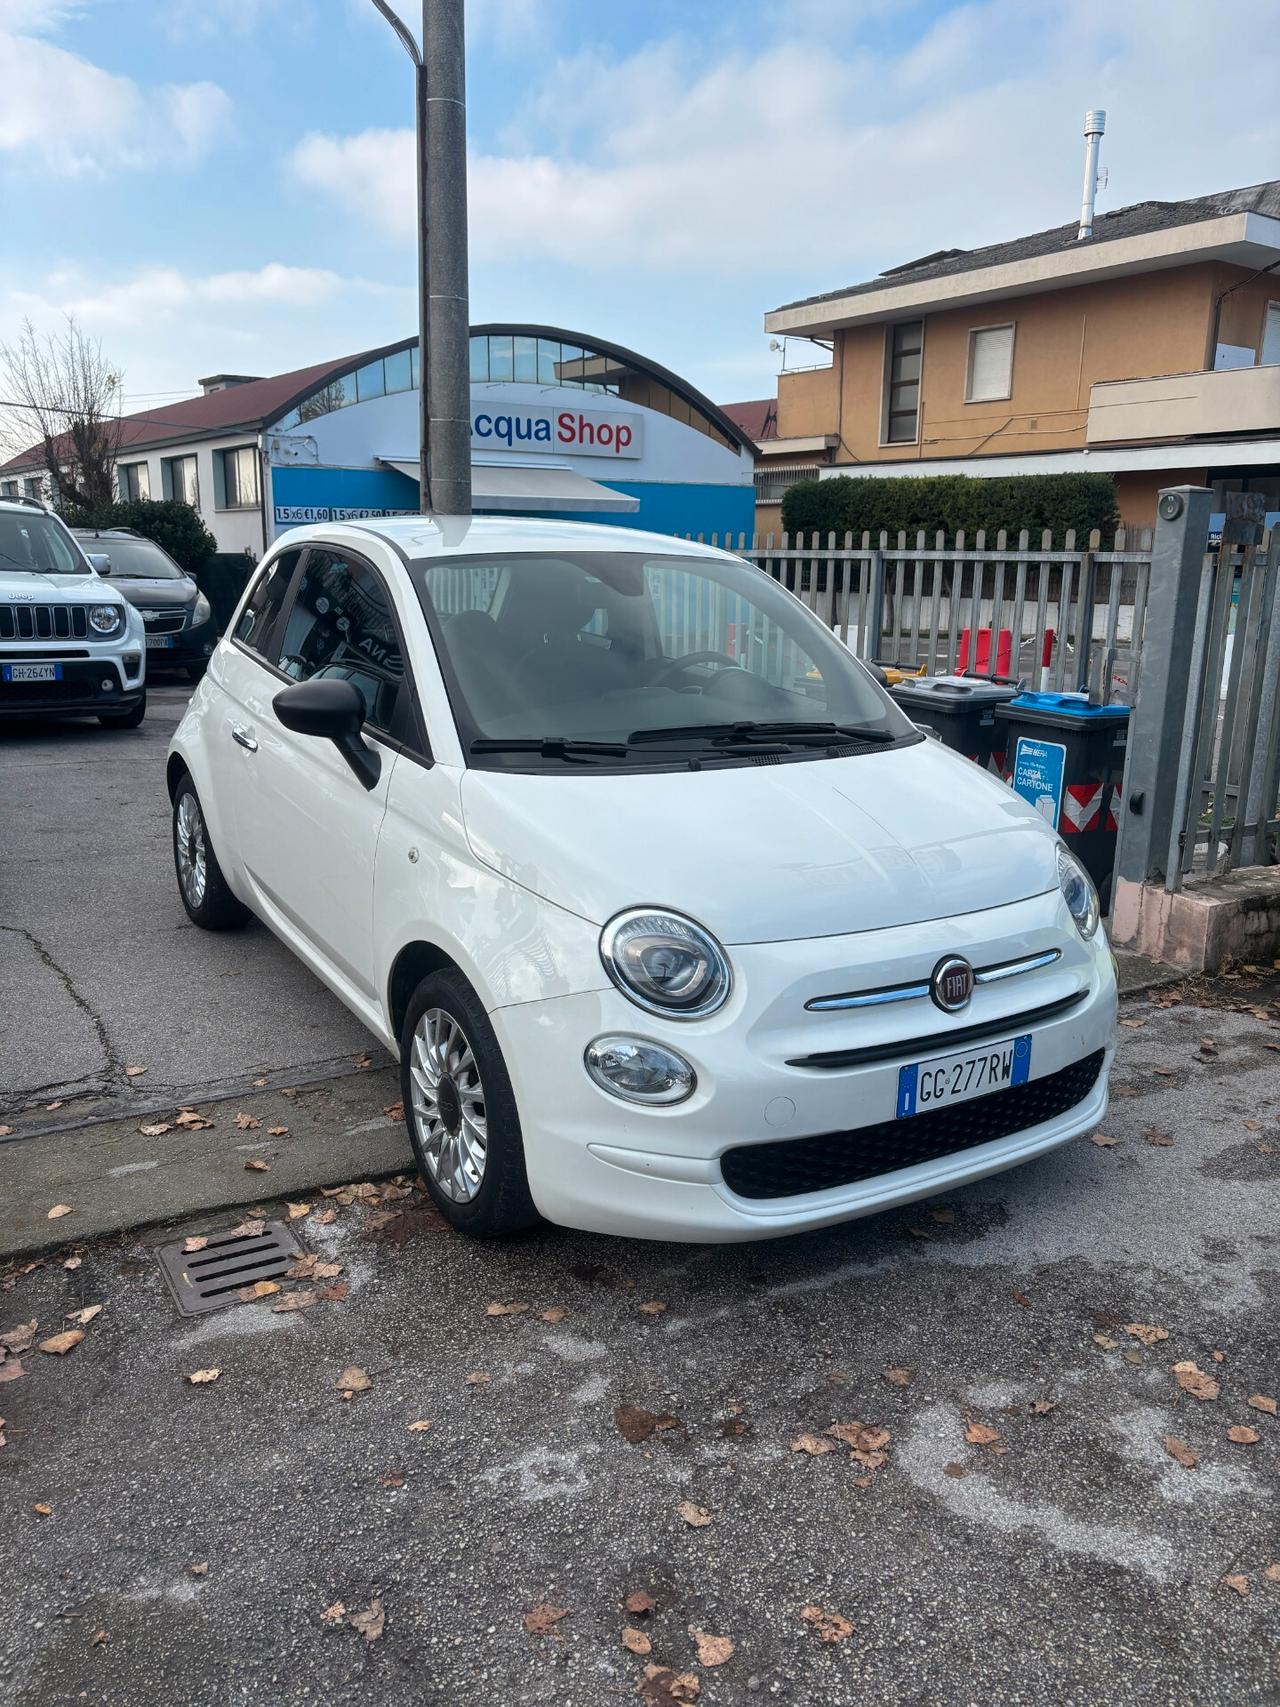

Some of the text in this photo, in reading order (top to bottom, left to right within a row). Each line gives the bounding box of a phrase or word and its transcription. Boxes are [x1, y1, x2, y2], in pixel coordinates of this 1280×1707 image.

[470, 412, 632, 453] cqua Shop
[1017, 777, 1053, 792] CARTONE
[946, 973, 967, 999] FIAT
